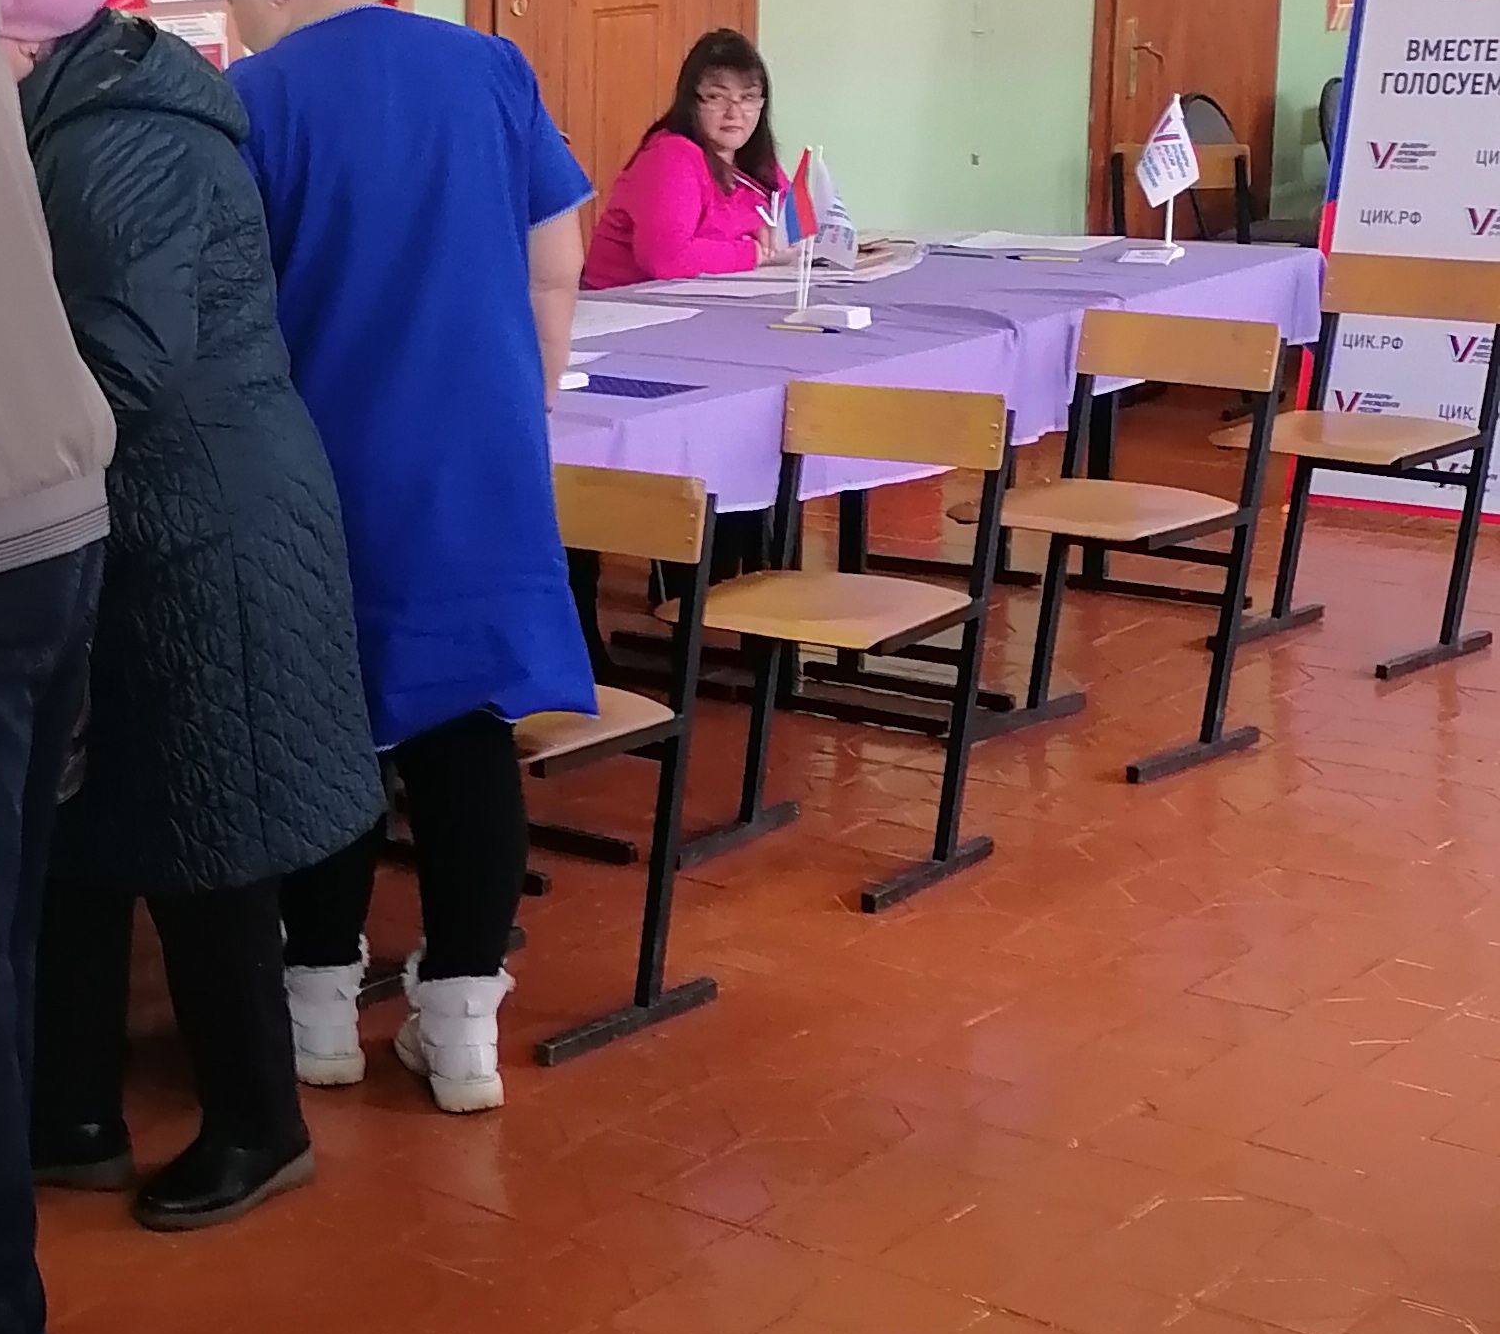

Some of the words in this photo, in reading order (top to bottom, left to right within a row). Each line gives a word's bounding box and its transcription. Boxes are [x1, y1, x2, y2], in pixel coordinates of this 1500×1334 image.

[1406, 39, 1499, 62] ВМЕСТЕ
[1380, 72, 1500, 95] ГОЛОСУЕМ
[1360, 209, 1422, 226] ЦИК.РФ
[1342, 332, 1404, 350] ЦИК.РФ
[1438, 403, 1477, 421] ЦИК.
